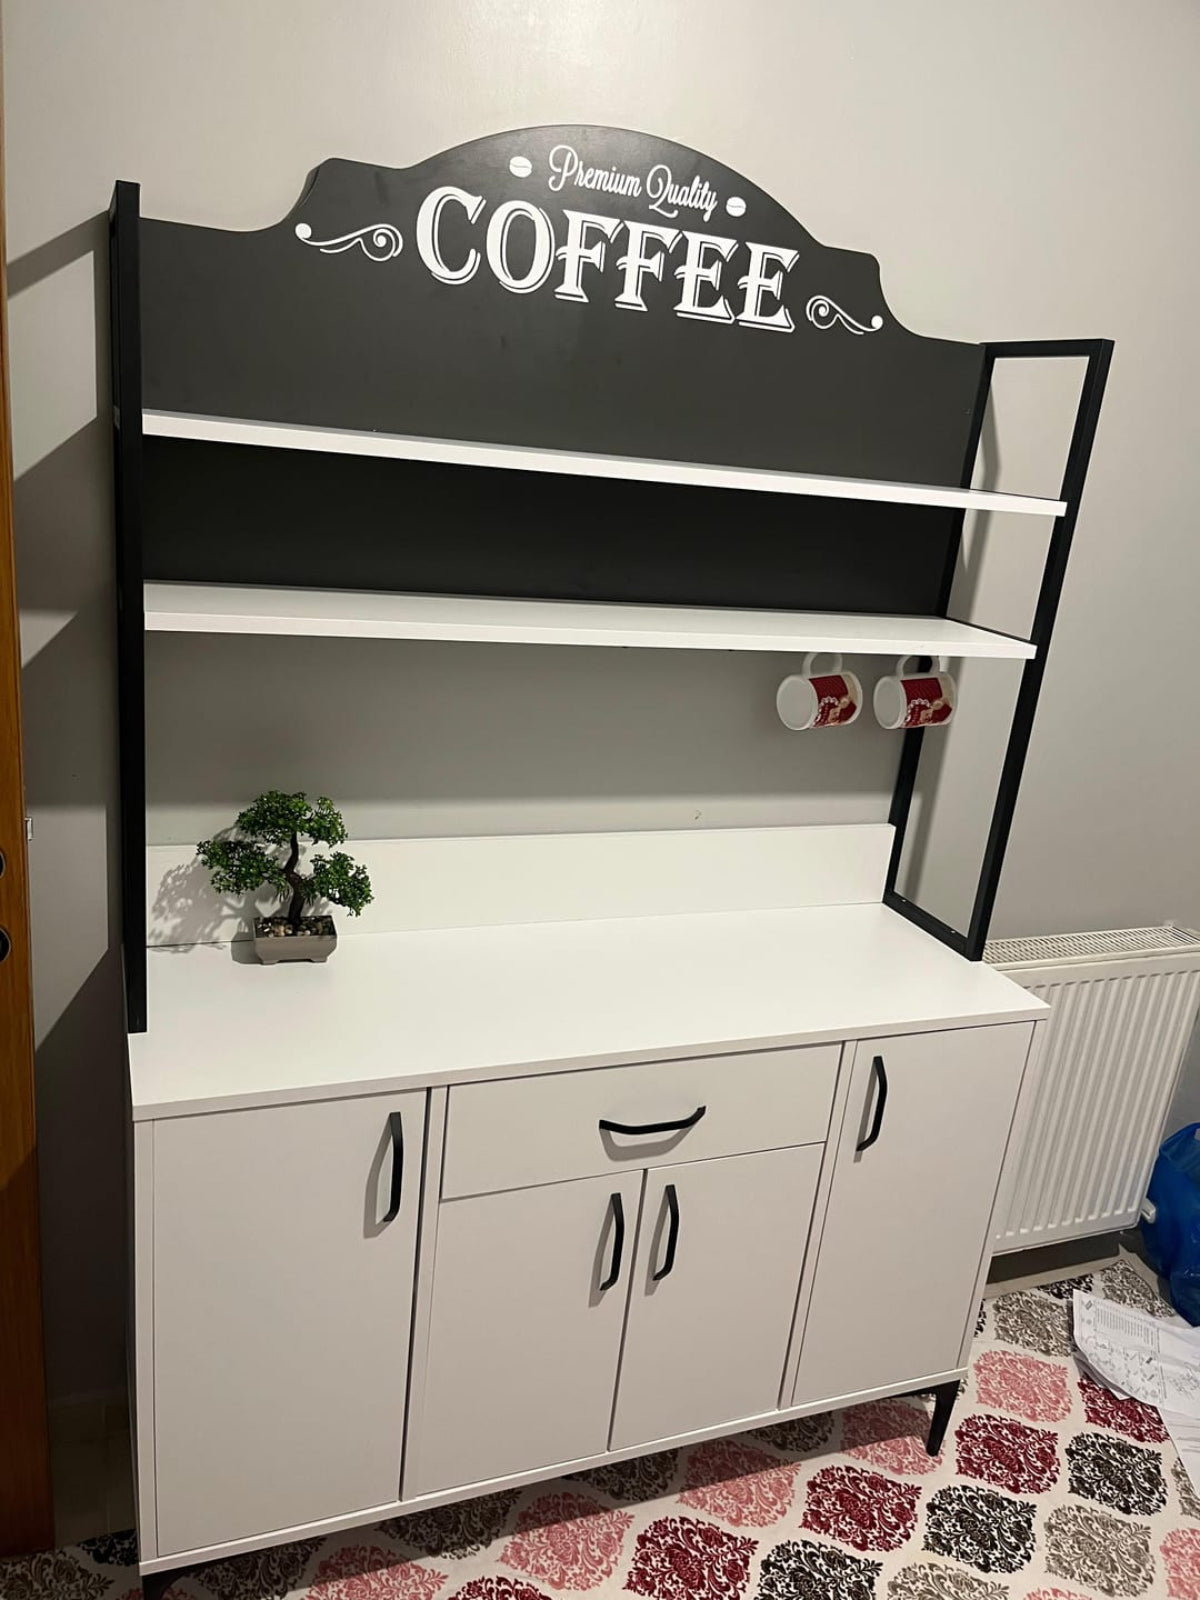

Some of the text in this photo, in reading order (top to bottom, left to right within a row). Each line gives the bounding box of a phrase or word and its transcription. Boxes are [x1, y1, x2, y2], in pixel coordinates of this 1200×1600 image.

[549, 145, 718, 222] Premium Quality
[416, 185, 799, 333] COFFEE
